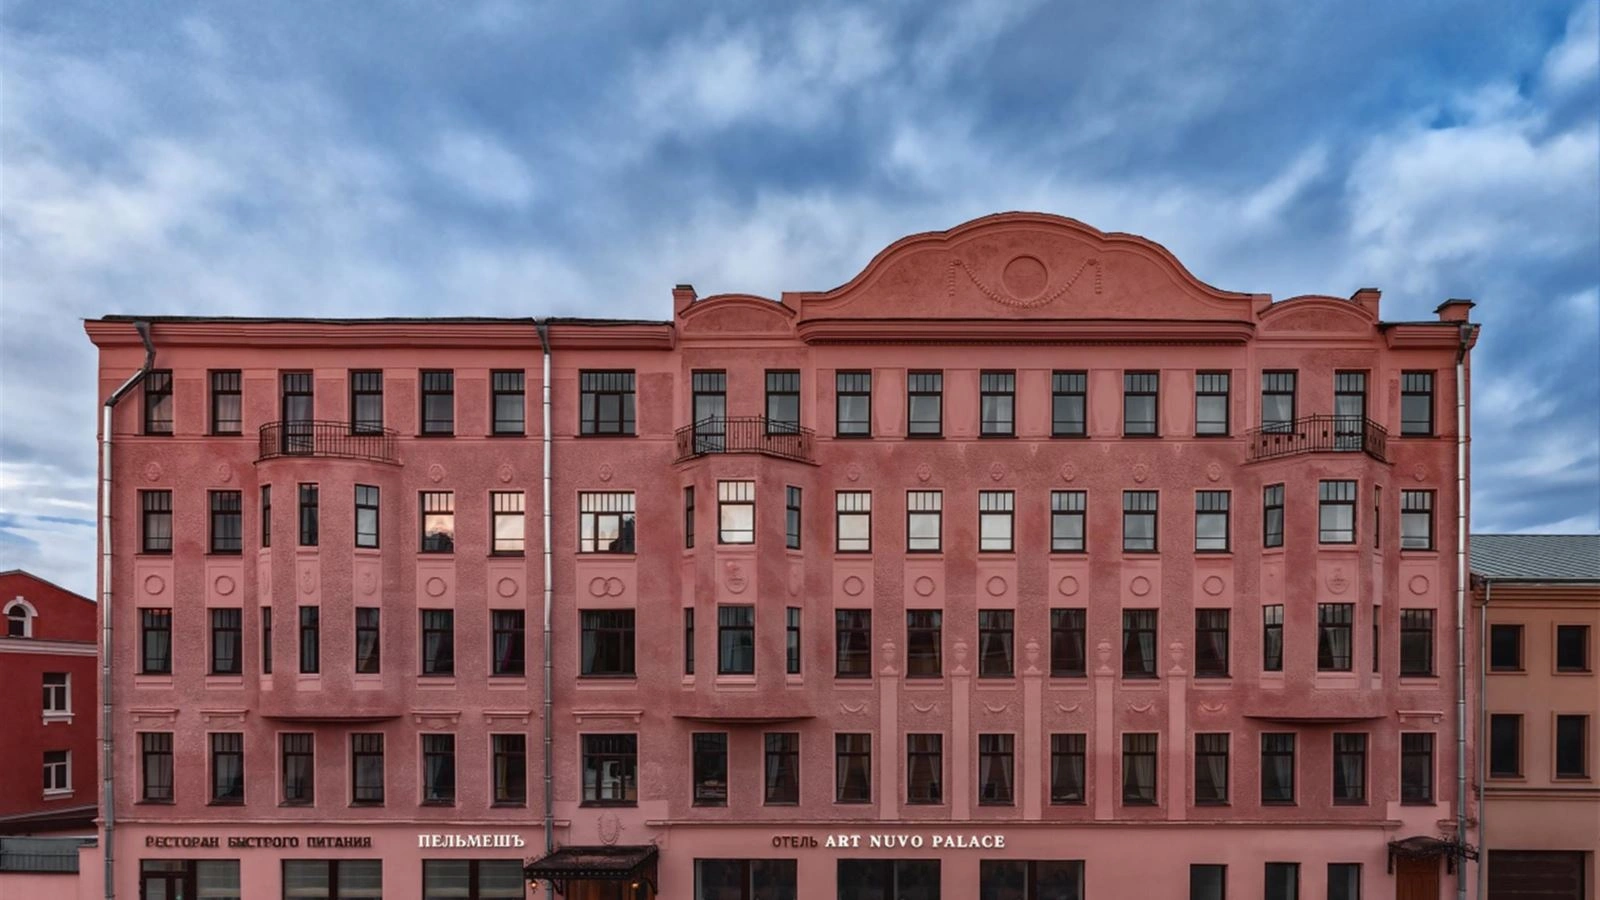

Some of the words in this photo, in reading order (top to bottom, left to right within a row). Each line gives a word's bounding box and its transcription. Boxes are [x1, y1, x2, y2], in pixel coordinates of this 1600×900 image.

[145, 836, 219, 848] РЕСТОРАН
[228, 836, 299, 848] БЫСТРОГО
[307, 836, 372, 848] ПИТАНИЯ
[418, 834, 525, 848] ПЕЛЬМЕШЪ
[772, 836, 818, 848] ОТЕЛЬ
[825, 835, 861, 848] ART
[870, 835, 923, 848] NUVO
[932, 835, 1005, 848] PALACE
